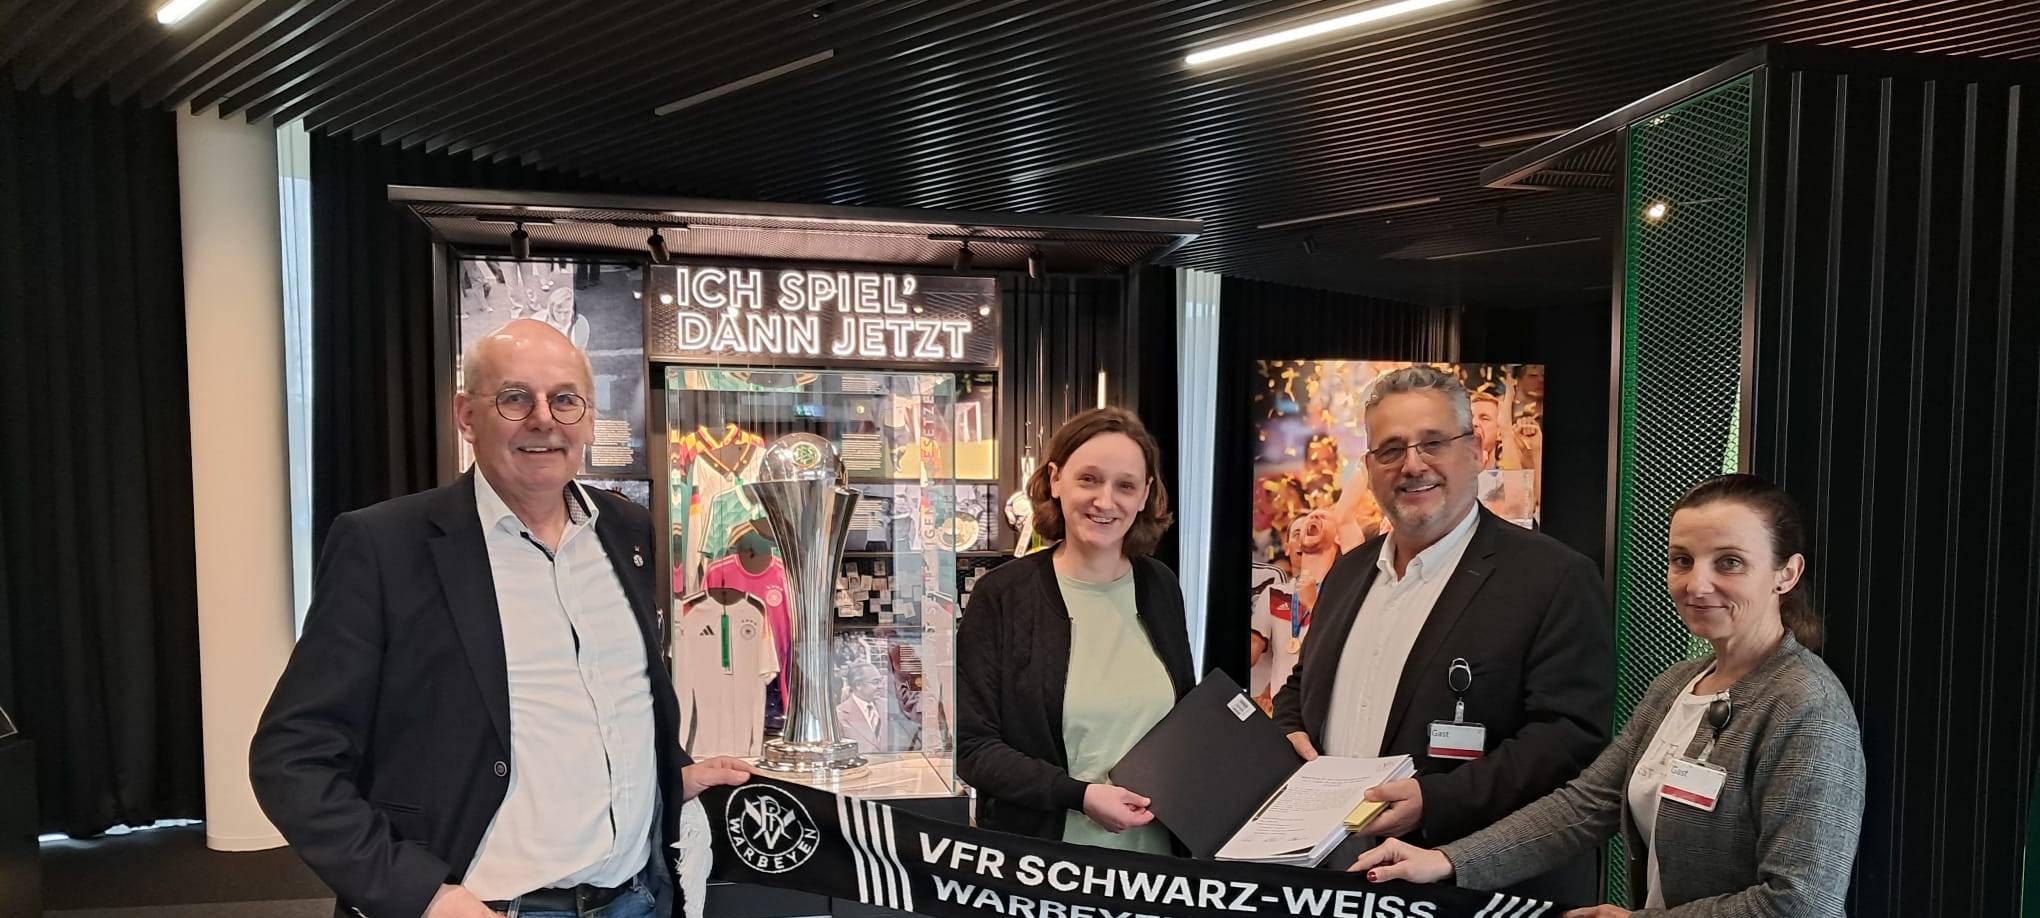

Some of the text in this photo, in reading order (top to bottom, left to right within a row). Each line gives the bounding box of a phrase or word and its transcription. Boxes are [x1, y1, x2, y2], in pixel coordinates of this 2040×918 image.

[676, 267, 918, 315] ICH SPIEL’
[677, 312, 973, 359] DANN JETZT
[1431, 729, 1449, 738] Gast
[1670, 765, 1689, 777] Gast
[728, 817, 817, 870] WARBEYEN
[918, 831, 1437, 918] VFR SCHWARZ-WEISS
[931, 874, 1172, 918] WARBE
